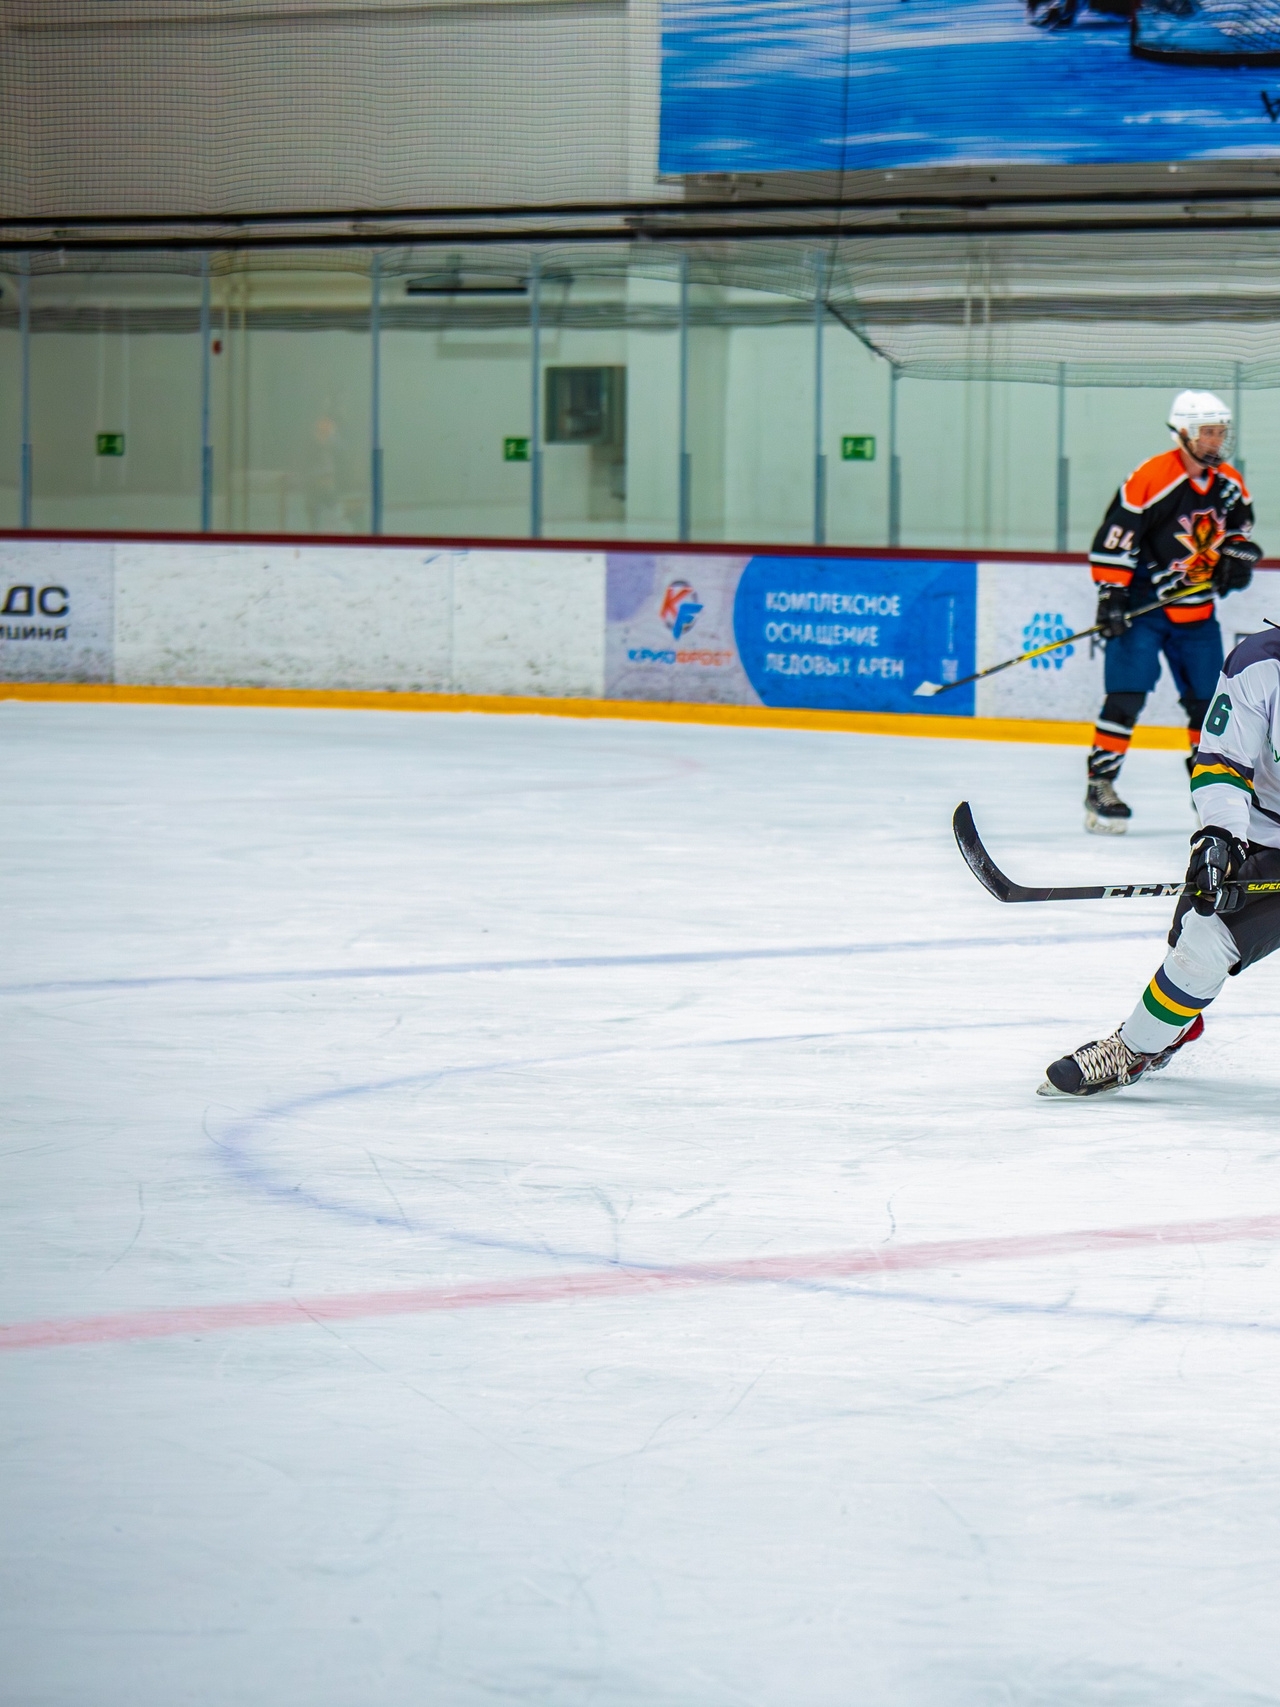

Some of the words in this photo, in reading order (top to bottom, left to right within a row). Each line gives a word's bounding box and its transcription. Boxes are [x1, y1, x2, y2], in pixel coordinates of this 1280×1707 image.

[1103, 525, 1135, 551] 64
[0, 585, 70, 618] ДС
[765, 592, 901, 616] КОМПЛЕКСНОЕ
[765, 622, 880, 647] ОСНАЩЕНИЕ
[765, 652, 850, 676] ЛЕДОВЫХ
[857, 657, 904, 678] АРЕН
[1206, 693, 1233, 736] 6
[1102, 883, 1187, 899] CCM
